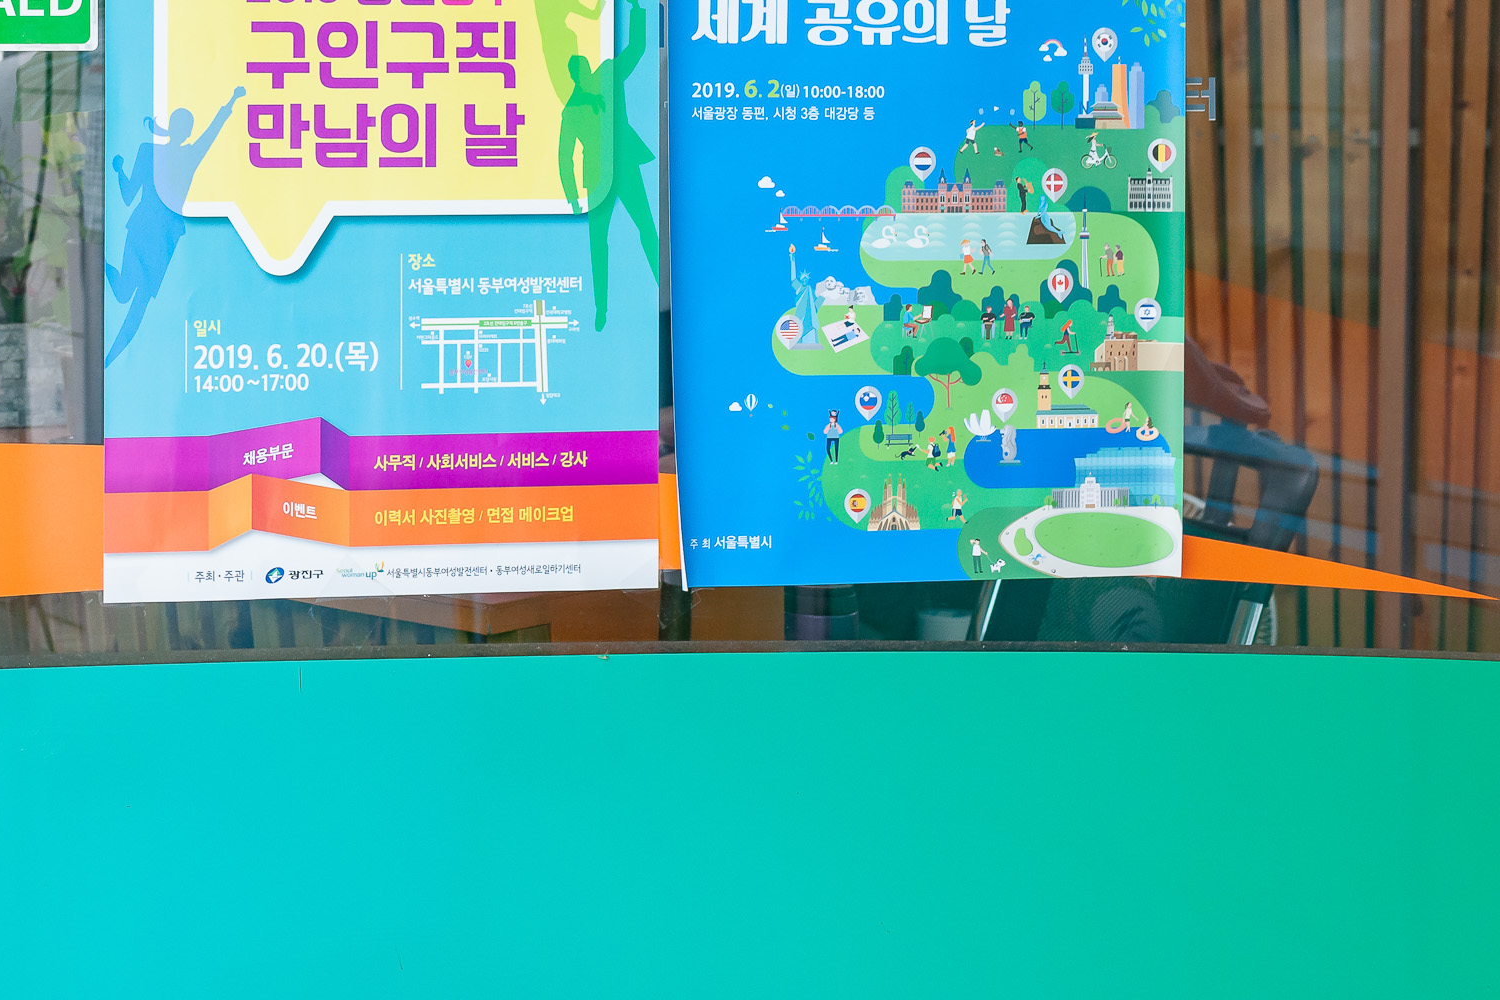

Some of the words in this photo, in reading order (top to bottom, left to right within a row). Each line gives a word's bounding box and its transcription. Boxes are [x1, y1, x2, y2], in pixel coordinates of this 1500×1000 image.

[246, 20, 517, 89] 구인구직
[692, 82, 740, 99] 2019.
[744, 79, 763, 99] 6.
[803, 85, 885, 99] 10:00-18:00
[692, 106, 738, 121] 서울광장
[741, 106, 769, 121] 동편,
[773, 106, 798, 121] 시청
[801, 106, 820, 121] 3층
[824, 106, 859, 121] 대강당
[863, 106, 876, 121] 등
[247, 103, 437, 168] 만남의
[464, 103, 526, 168] 날
[408, 253, 436, 269] 장소
[408, 277, 474, 296] 서울특별시
[477, 275, 583, 295] 동부여성발전센터
[194, 320, 221, 337] 일시
[194, 345, 258, 371] 2019.
[267, 344, 288, 369] 6.
[243, 443, 294, 467] 채용부문
[374, 454, 416, 472] 사무직
[427, 452, 497, 471] 사회서비스
[507, 451, 550, 469] 서비스
[560, 450, 589, 468] 강사
[282, 501, 318, 520] 이벤트
[375, 509, 416, 527] 이력서
[419, 507, 476, 526] 사진촬영
[486, 506, 515, 524] 면접
[518, 505, 575, 523] 메이크업
[714, 535, 773, 550] 서울특별시
[288, 569, 324, 580] 광진구
[365, 570, 378, 581] up
